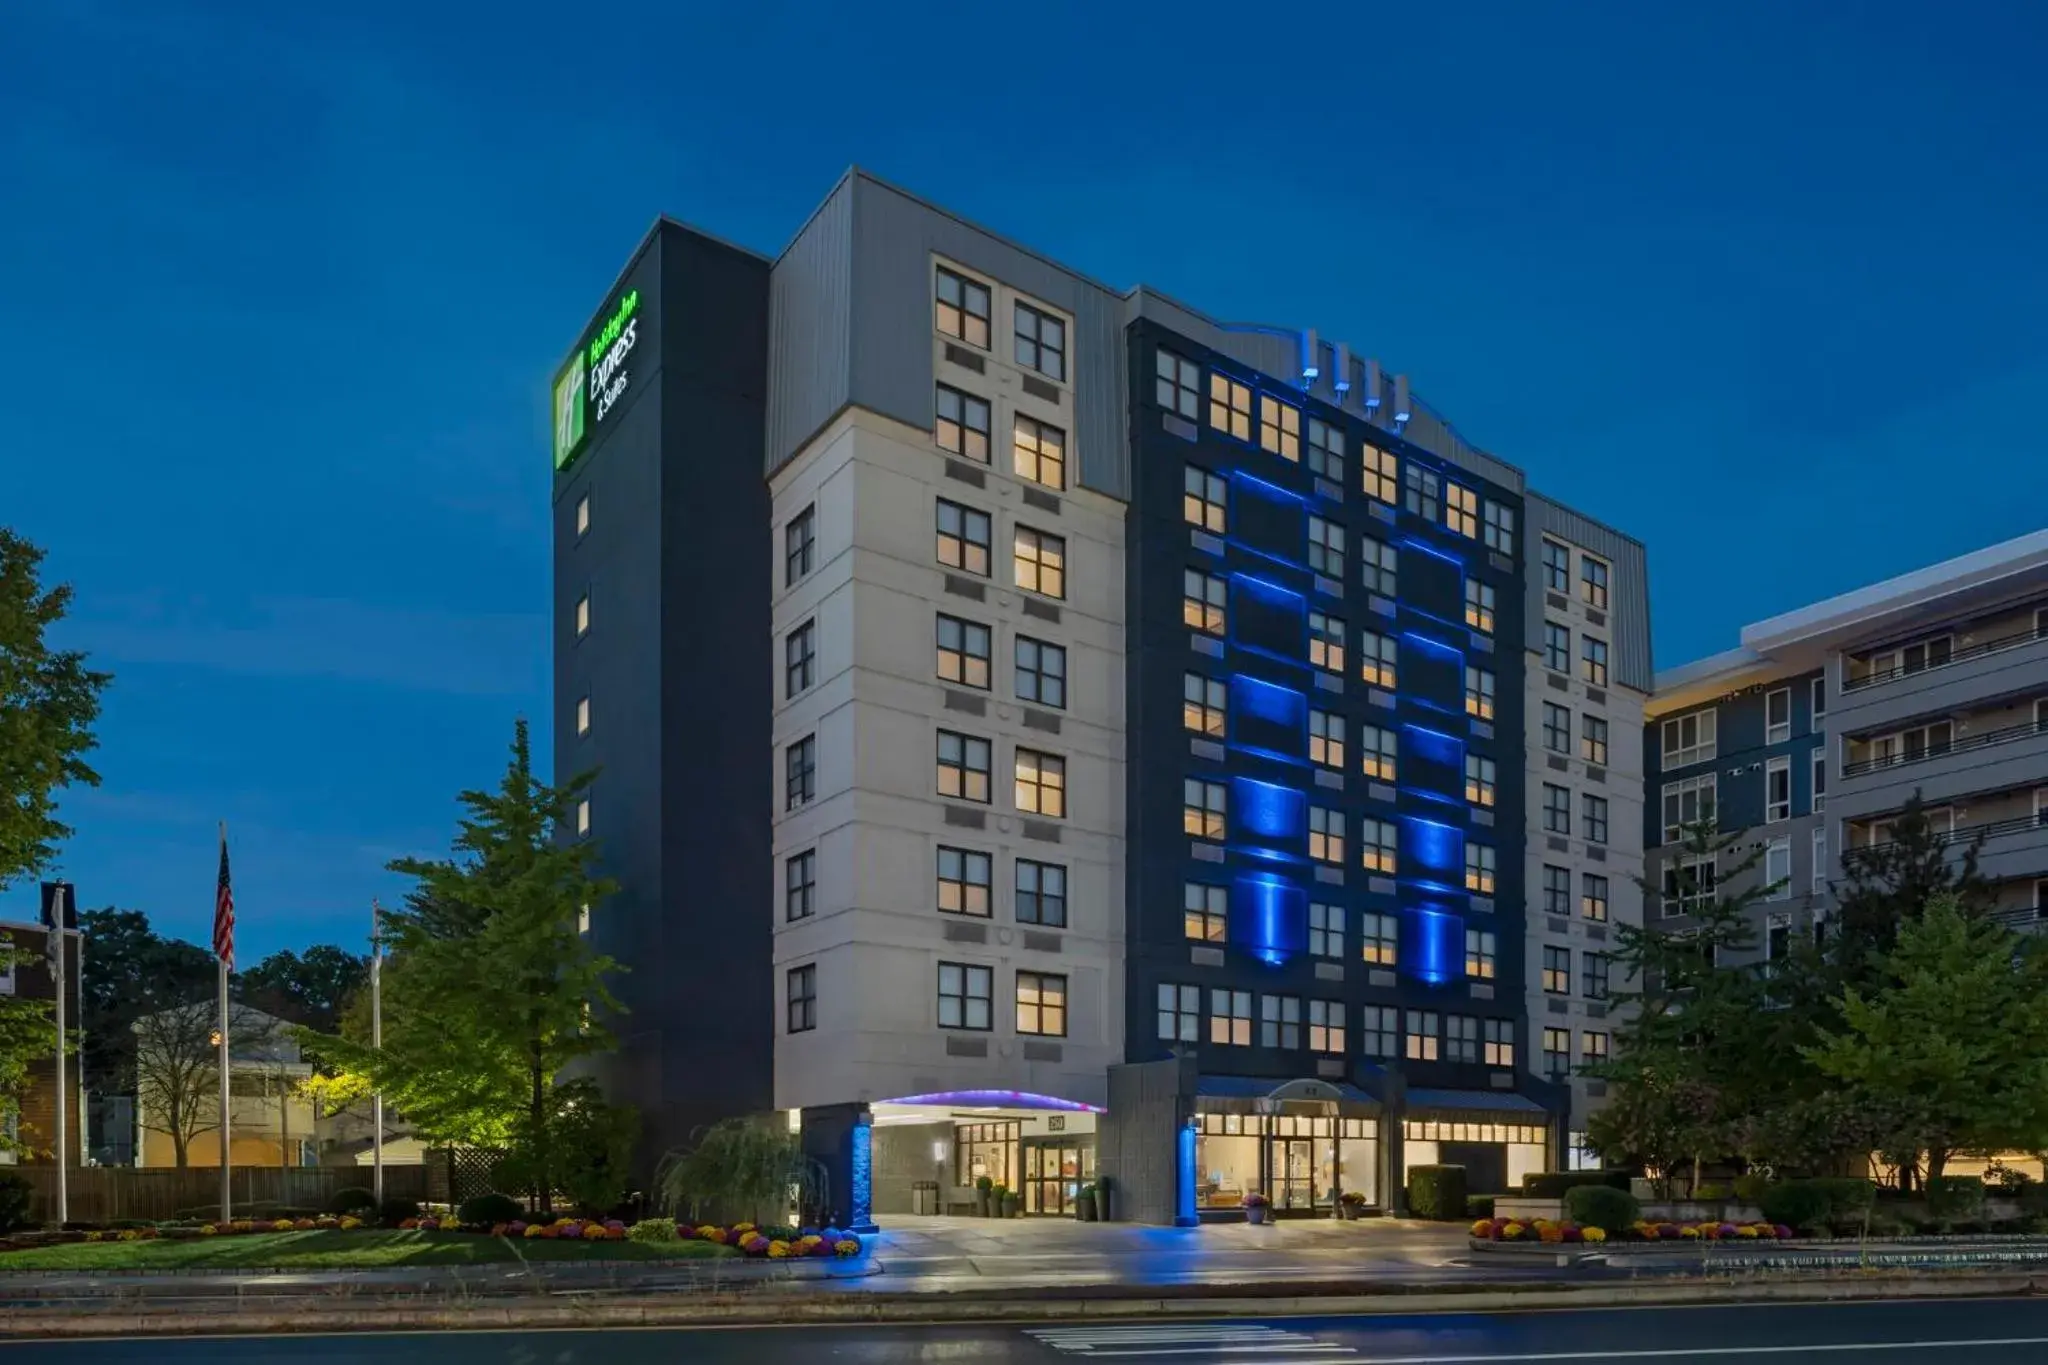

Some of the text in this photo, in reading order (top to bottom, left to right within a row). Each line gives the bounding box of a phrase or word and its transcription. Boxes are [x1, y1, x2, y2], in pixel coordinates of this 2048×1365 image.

[590, 290, 637, 368] Holiday Inn
[590, 318, 637, 402] Express
[603, 371, 628, 413] Suites
